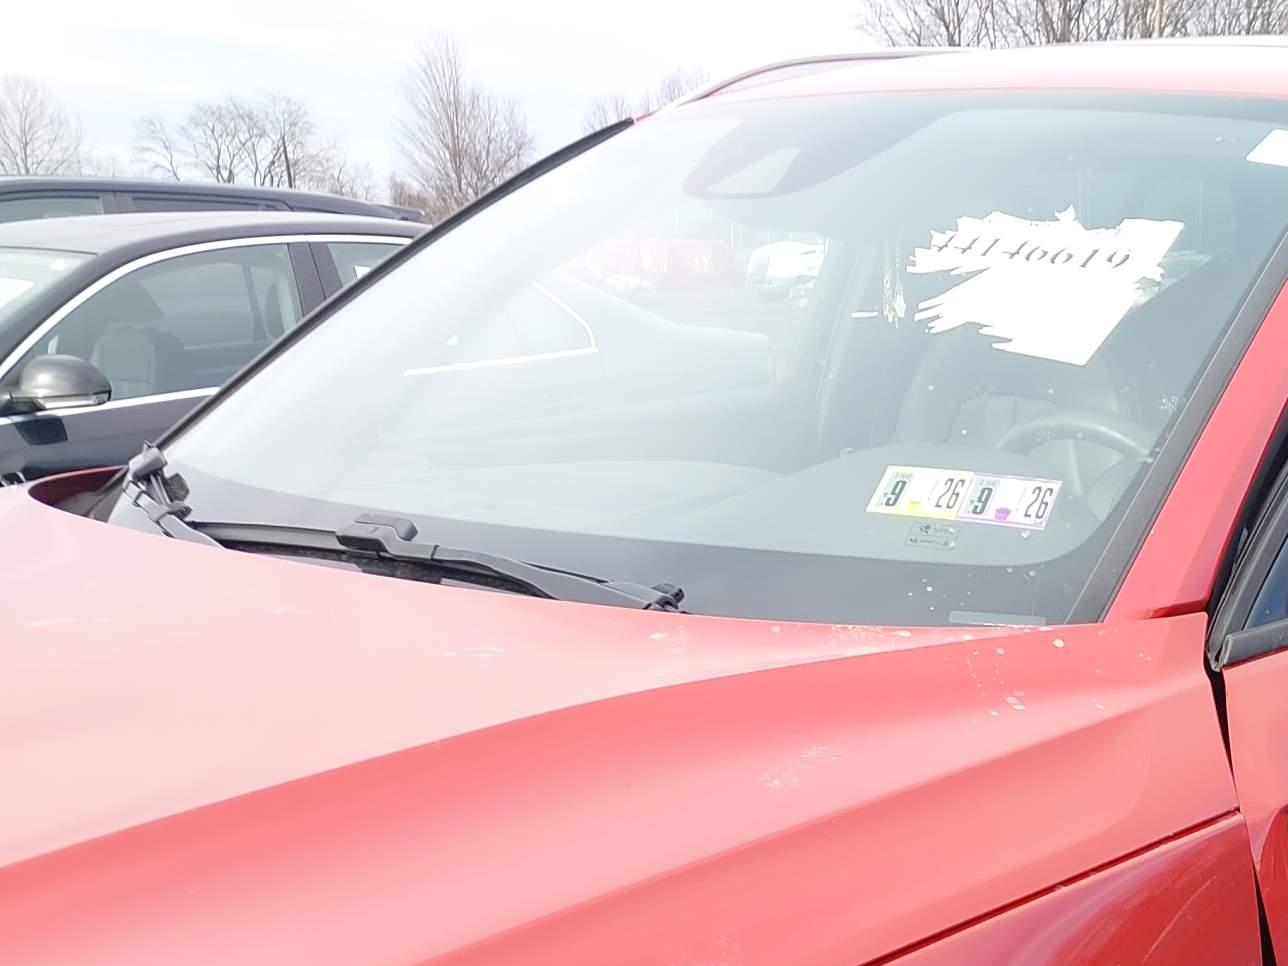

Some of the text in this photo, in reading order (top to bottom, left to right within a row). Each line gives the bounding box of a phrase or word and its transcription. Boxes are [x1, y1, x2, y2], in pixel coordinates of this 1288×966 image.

[885, 478, 965, 509] 9 26
[972, 486, 1053, 519] 9 26
